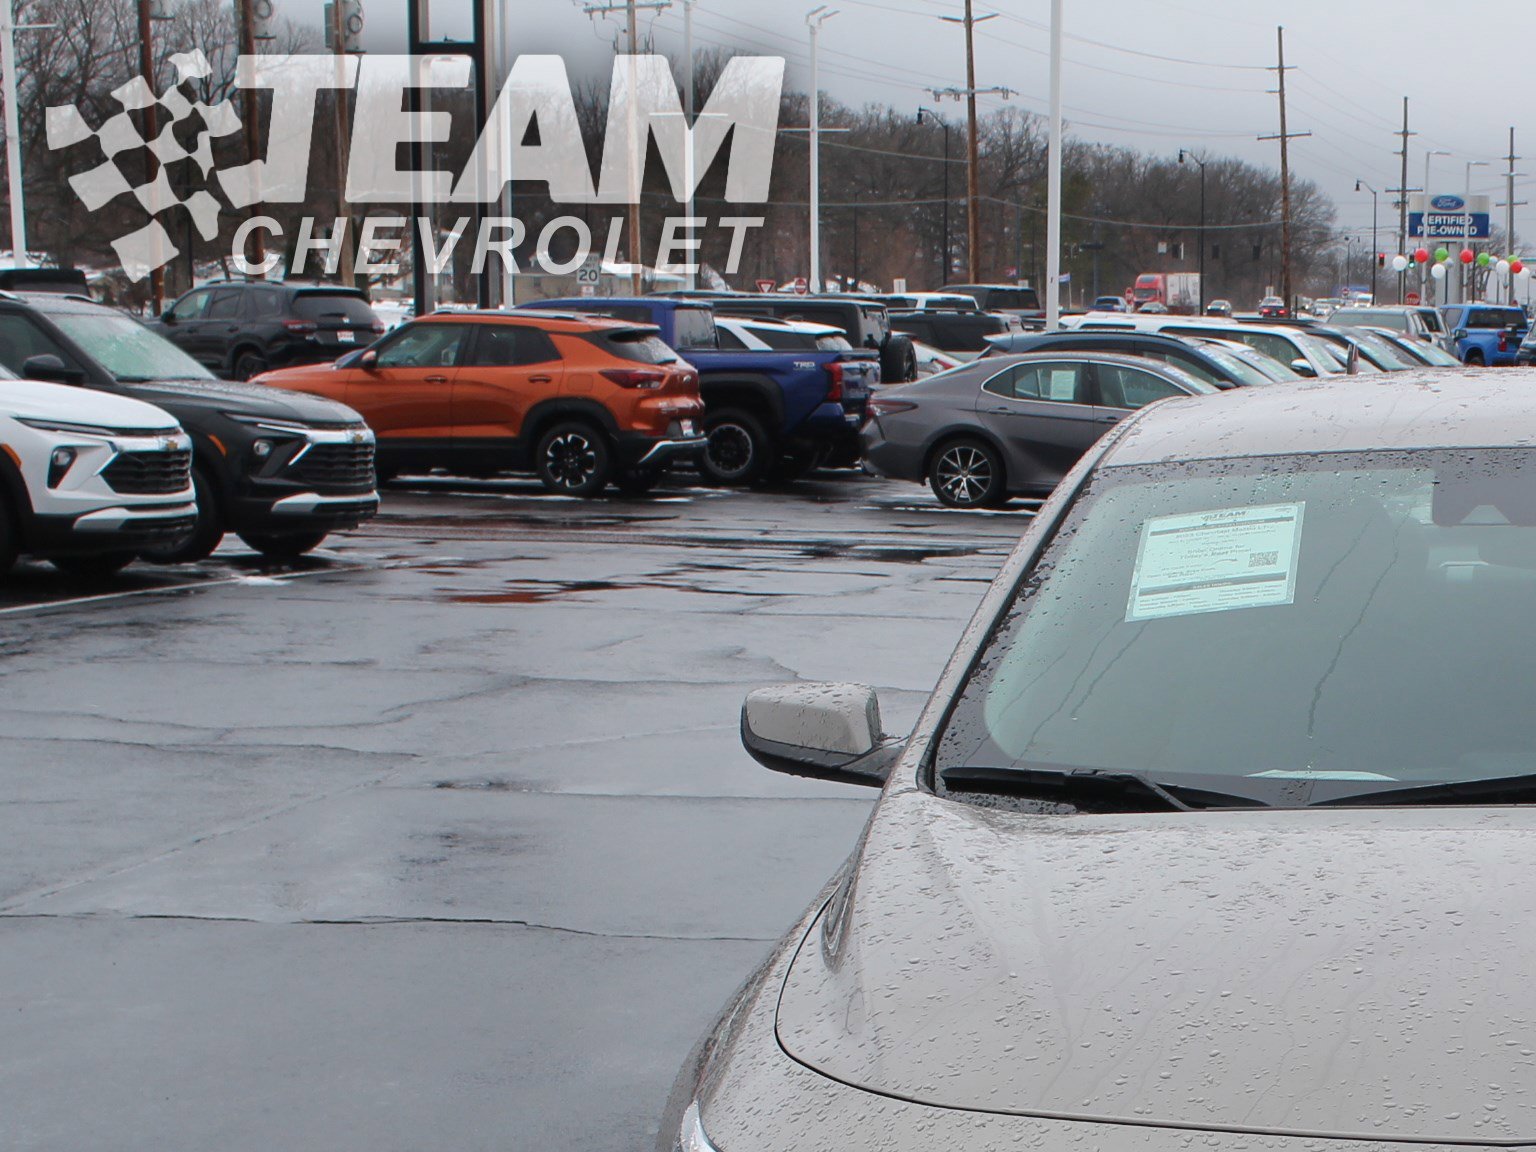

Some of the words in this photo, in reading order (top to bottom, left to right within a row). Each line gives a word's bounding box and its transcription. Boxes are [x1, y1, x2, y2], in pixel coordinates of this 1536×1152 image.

[1417, 225, 1477, 235] PE-OWND
[579, 269, 598, 282] 20
[793, 361, 815, 369] TRD
